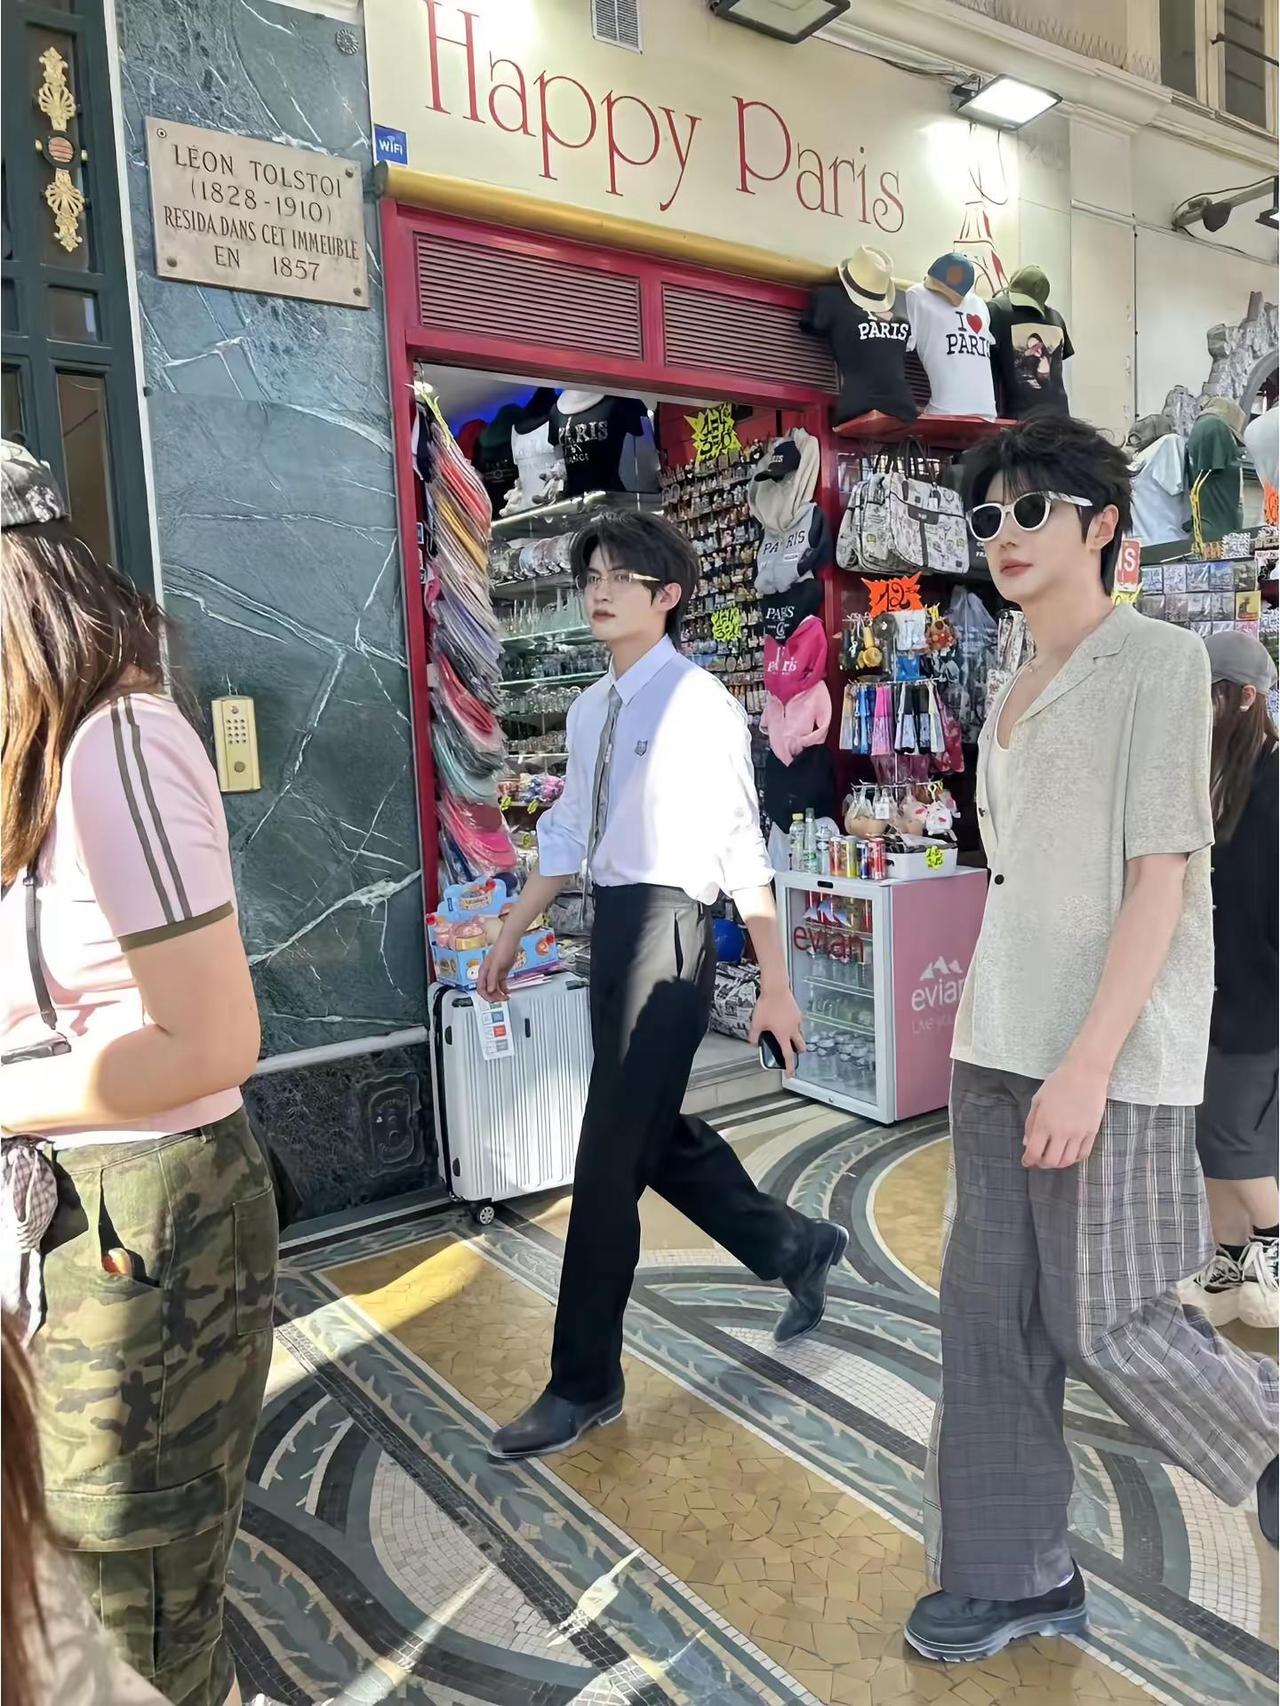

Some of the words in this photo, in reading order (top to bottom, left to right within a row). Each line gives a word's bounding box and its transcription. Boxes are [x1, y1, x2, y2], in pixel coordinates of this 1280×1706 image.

[422, 0, 702, 211] Happy
[732, 95, 905, 233] Paris
[172, 144, 234, 177] LÉON
[163, 205, 217, 235] RESIDA
[220, 215, 257, 242] DANS
[261, 223, 286, 247] CET
[292, 230, 360, 261] IMMEUBLE
[214, 245, 240, 269] EN
[273, 256, 321, 282] 1857
[858, 321, 910, 342] PARIS
[793, 926, 864, 964] evian
